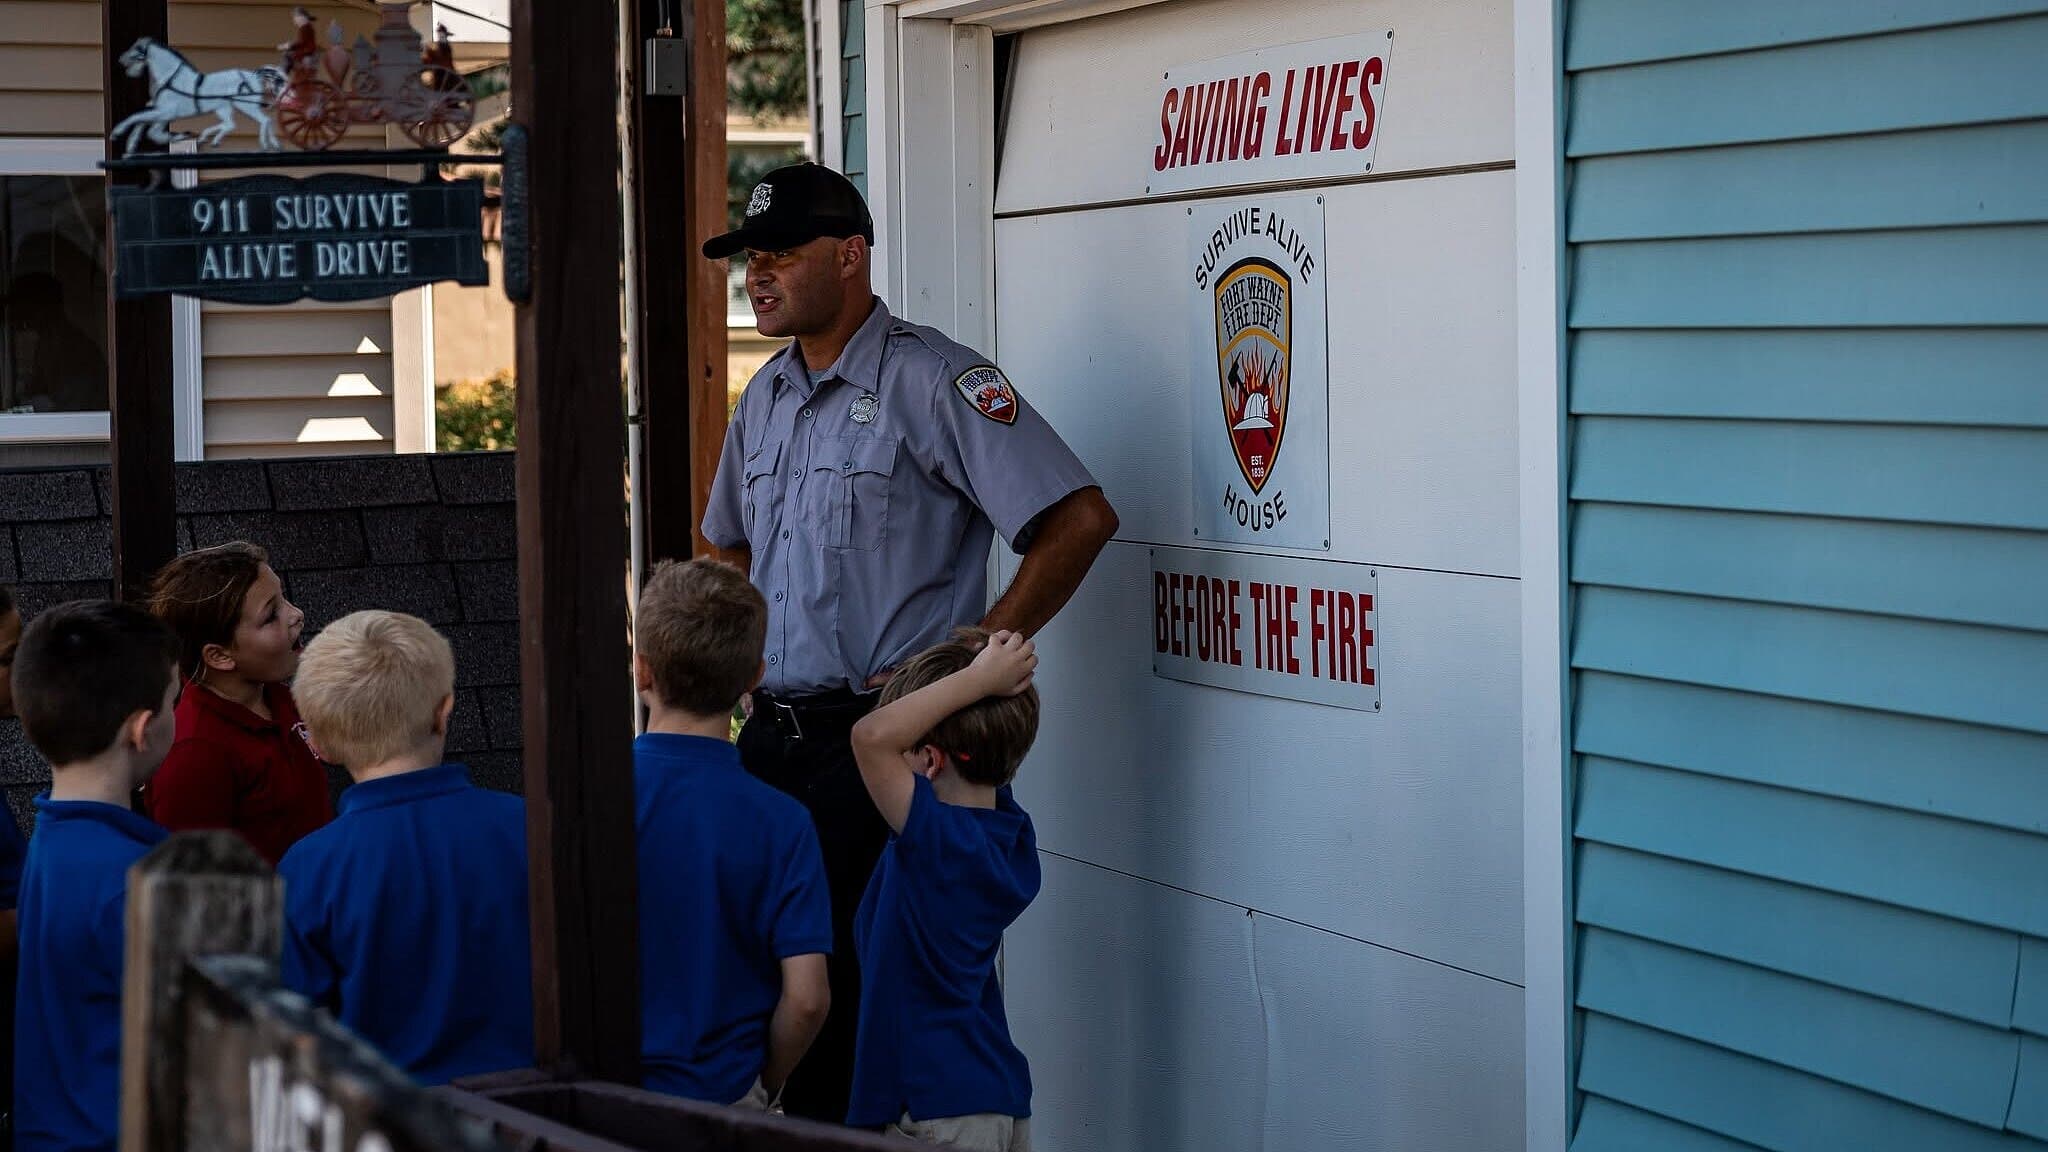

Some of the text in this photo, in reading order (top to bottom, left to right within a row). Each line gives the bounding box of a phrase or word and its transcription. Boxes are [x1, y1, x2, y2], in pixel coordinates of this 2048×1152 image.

[1154, 56, 1383, 172] SAVING LIVES
[192, 192, 411, 232] 911 SURVIVE
[201, 240, 409, 281] ALIVE DRIVE
[1195, 207, 1315, 291] SURVIVE ALIVE
[1220, 275, 1285, 318] FORT WAYNE
[1224, 302, 1250, 342] FIRE
[1250, 455, 1264, 466] EST.
[1223, 483, 1287, 532] HOUSE
[1154, 570, 1376, 686] BEFORE THE FIRE
